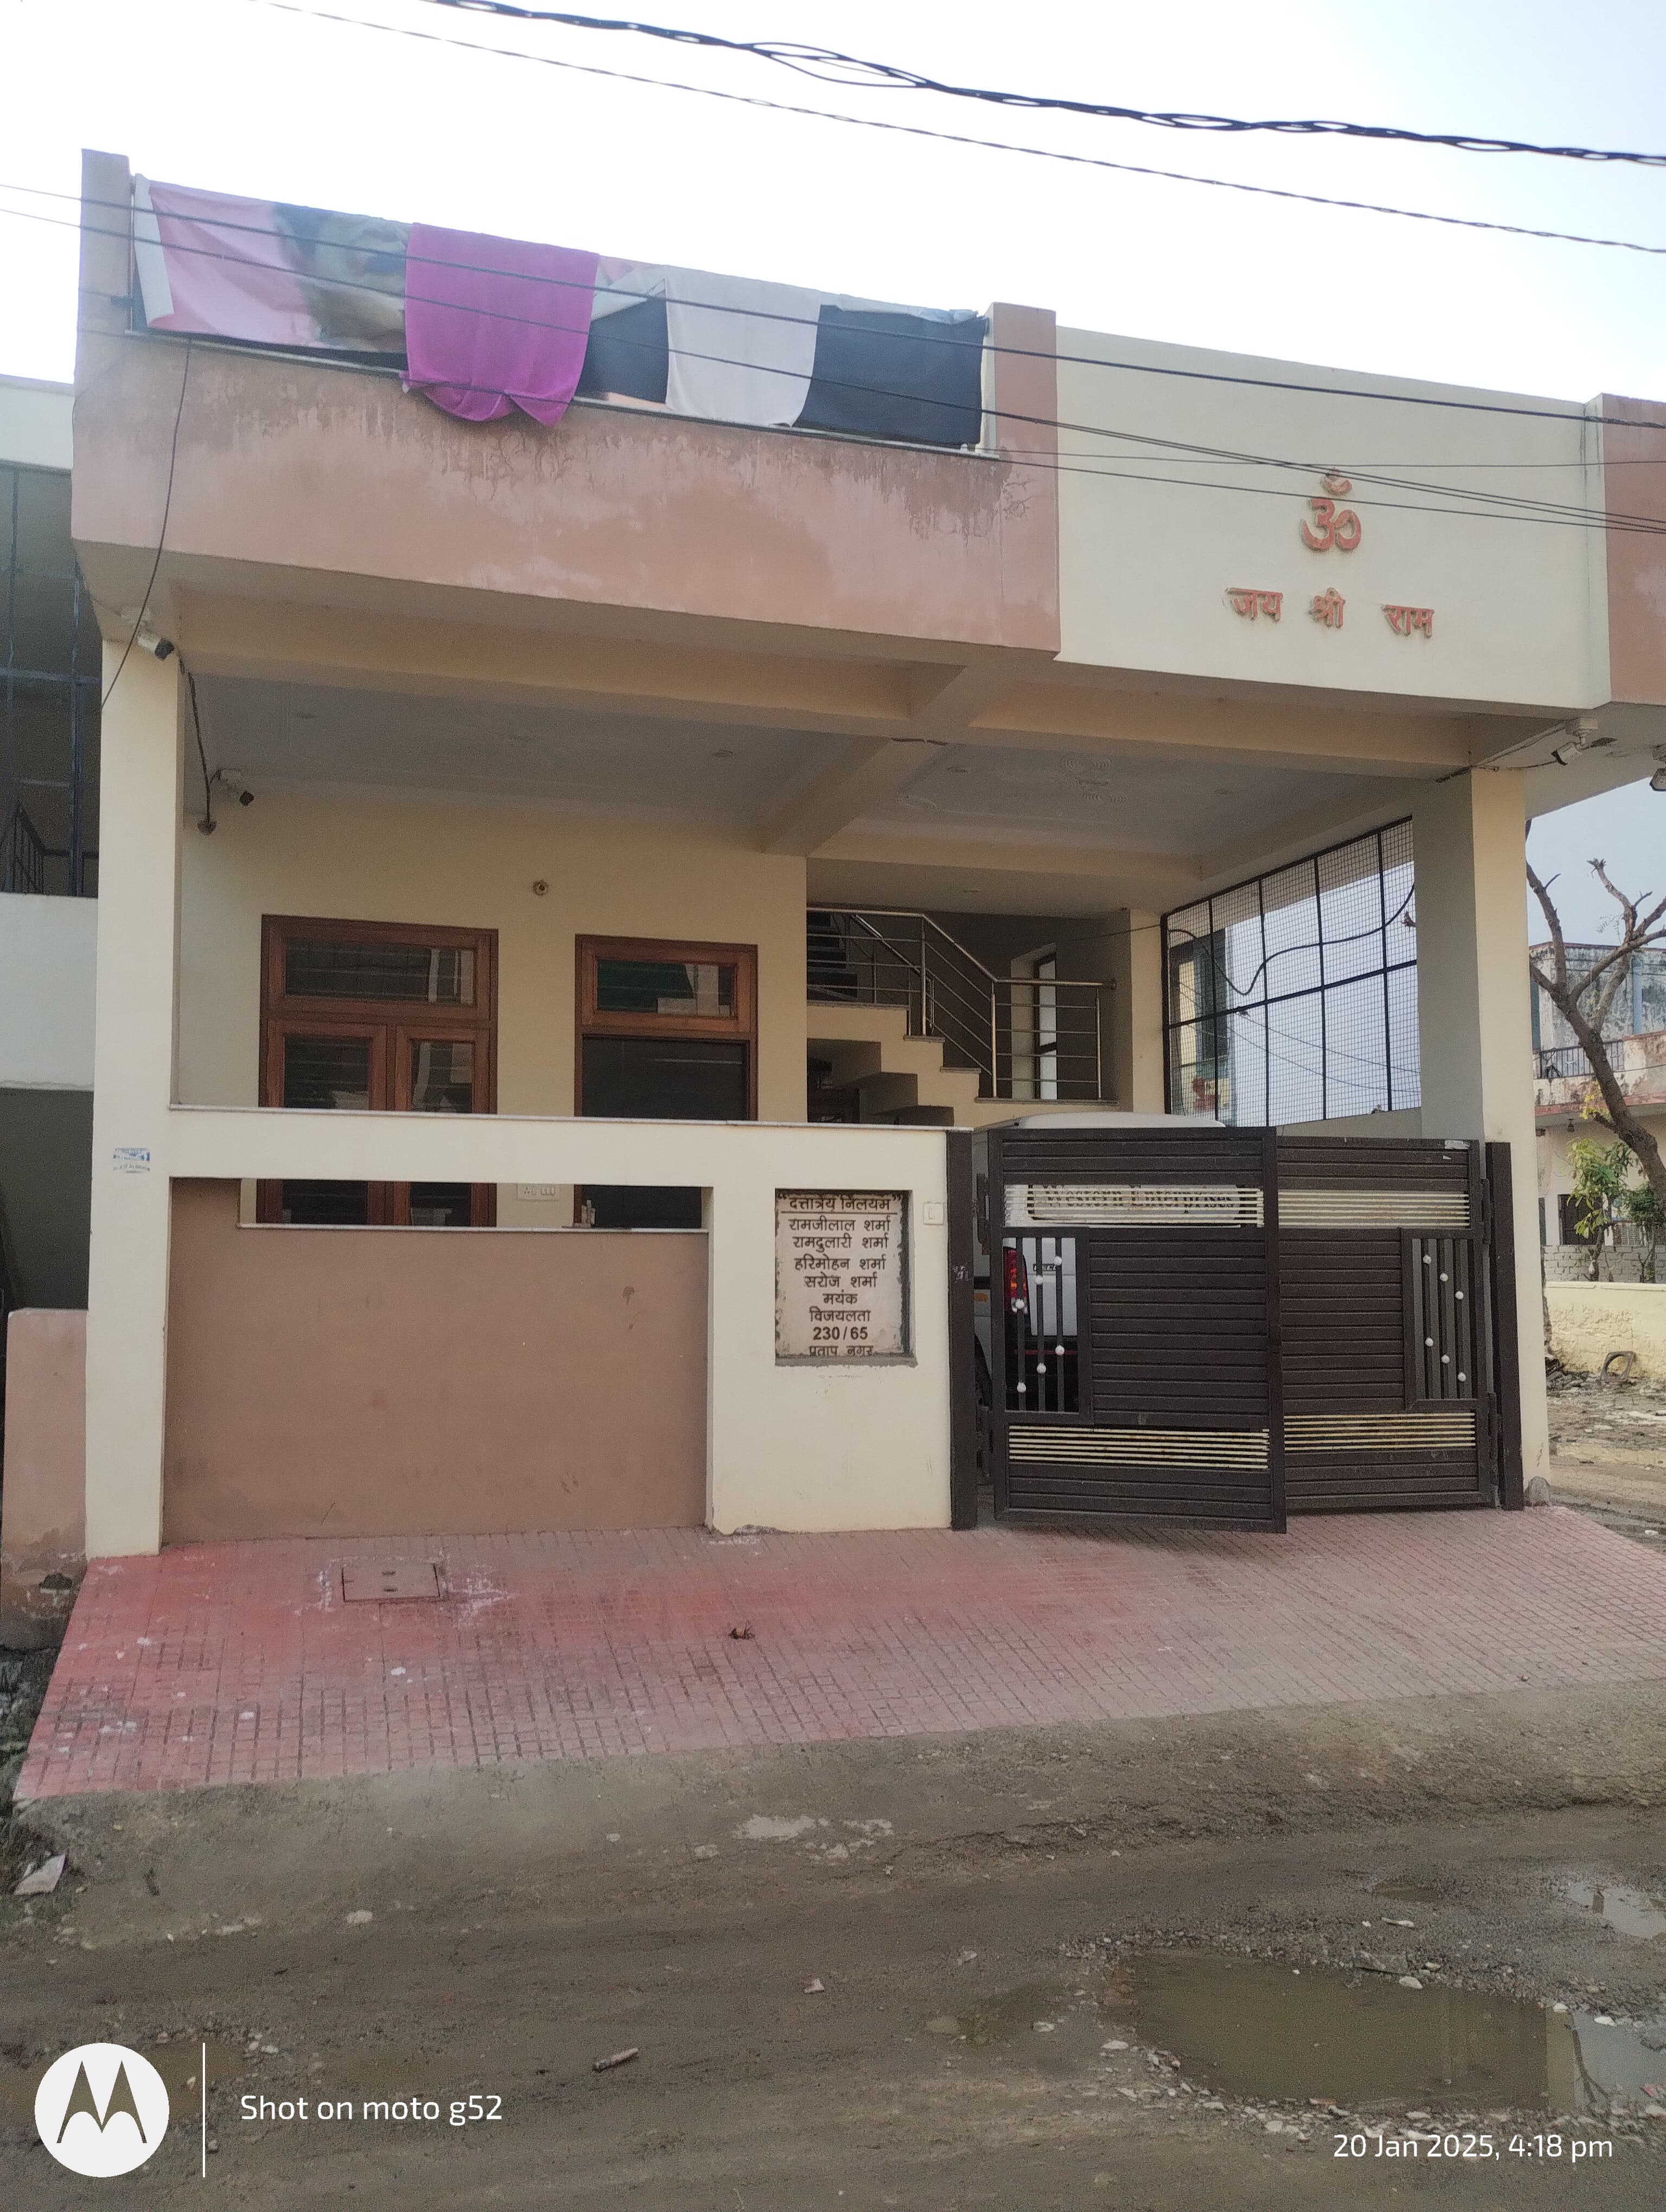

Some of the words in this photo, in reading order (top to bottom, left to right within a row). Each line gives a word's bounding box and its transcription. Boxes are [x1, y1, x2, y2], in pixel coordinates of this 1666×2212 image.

[1227, 587, 1283, 622] जय
[1309, 587, 1345, 628] श्री
[1381, 604, 1435, 638] राम
[789, 1215, 856, 1231] रामजीलाल
[864, 1215, 891, 1231] शर्मा
[792, 1232, 853, 1252] रामदुलारी
[862, 1232, 889, 1249] शर्मा
[794, 1253, 850, 1270] हरिमोहन
[860, 1253, 886, 1270] शर्मा
[804, 1271, 841, 1288] सरोज
[850, 1271, 877, 1288] शर्मा
[822, 1289, 858, 1305] मयंक
[809, 1306, 871, 1322] विजयलता
[846, 1345, 874, 1356] नगर
